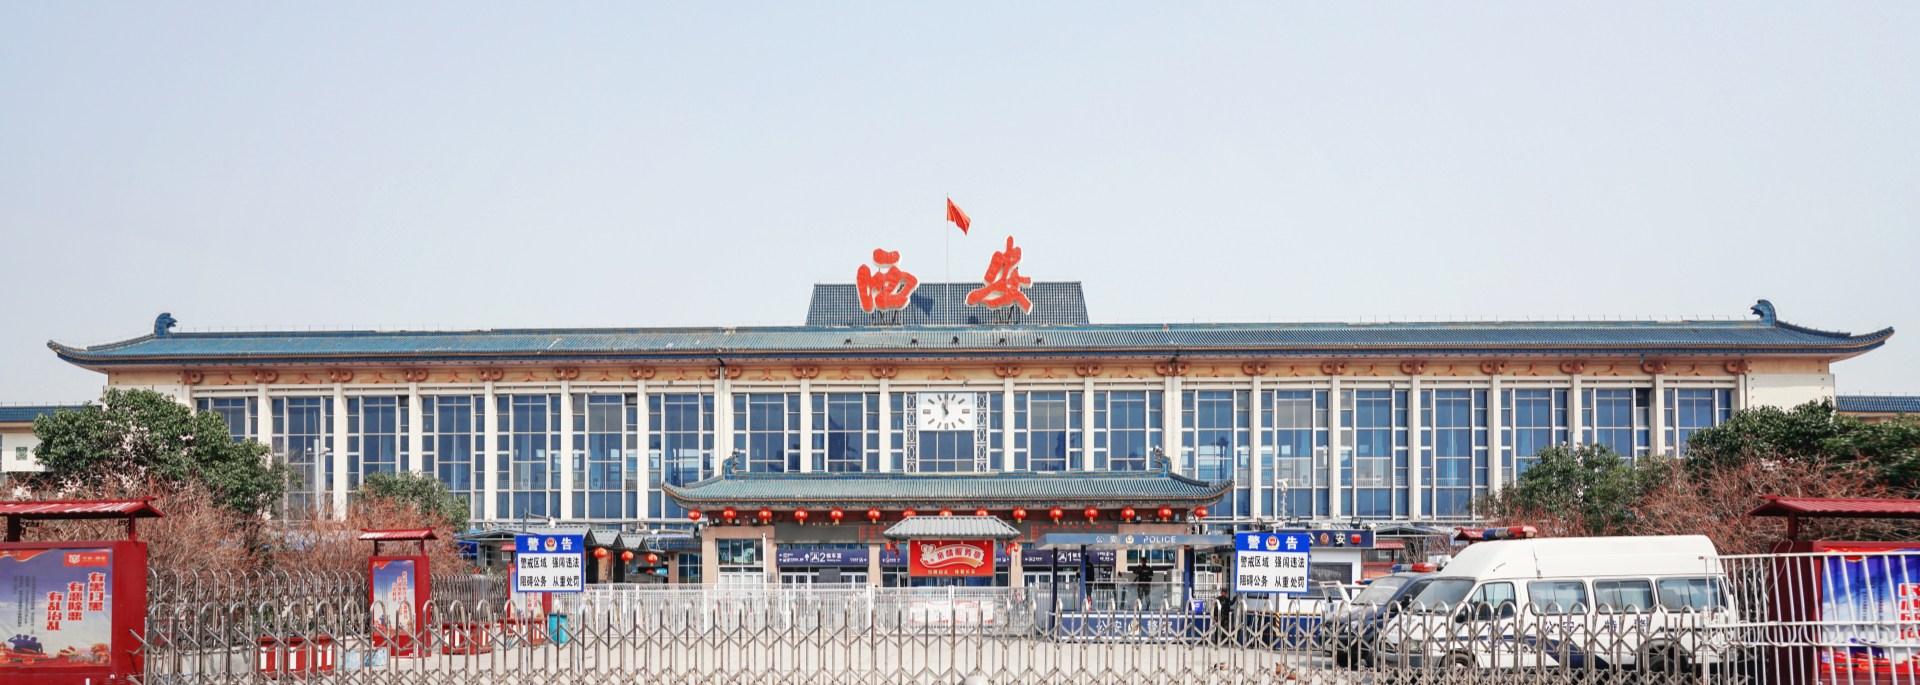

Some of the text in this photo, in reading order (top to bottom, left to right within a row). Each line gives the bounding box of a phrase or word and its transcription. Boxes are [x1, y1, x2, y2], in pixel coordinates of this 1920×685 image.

[856, 235, 1033, 315] 西安
[527, 537, 572, 551] 警告
[1143, 535, 1177, 543] POLICE
[1247, 535, 1298, 550] 警告
[521, 557, 580, 568] 警戒区域 强闯违法
[1240, 556, 1305, 568] 警戒区域 强闯违法
[520, 576, 580, 587] 阻碍公务 从重处罚
[1239, 575, 1305, 588] 阻碍公务 从重处罚
[88, 572, 106, 612] 有黑扫黑
[67, 582, 85, 621] 有恶除恶
[47, 591, 65, 631] 有乱治乱
